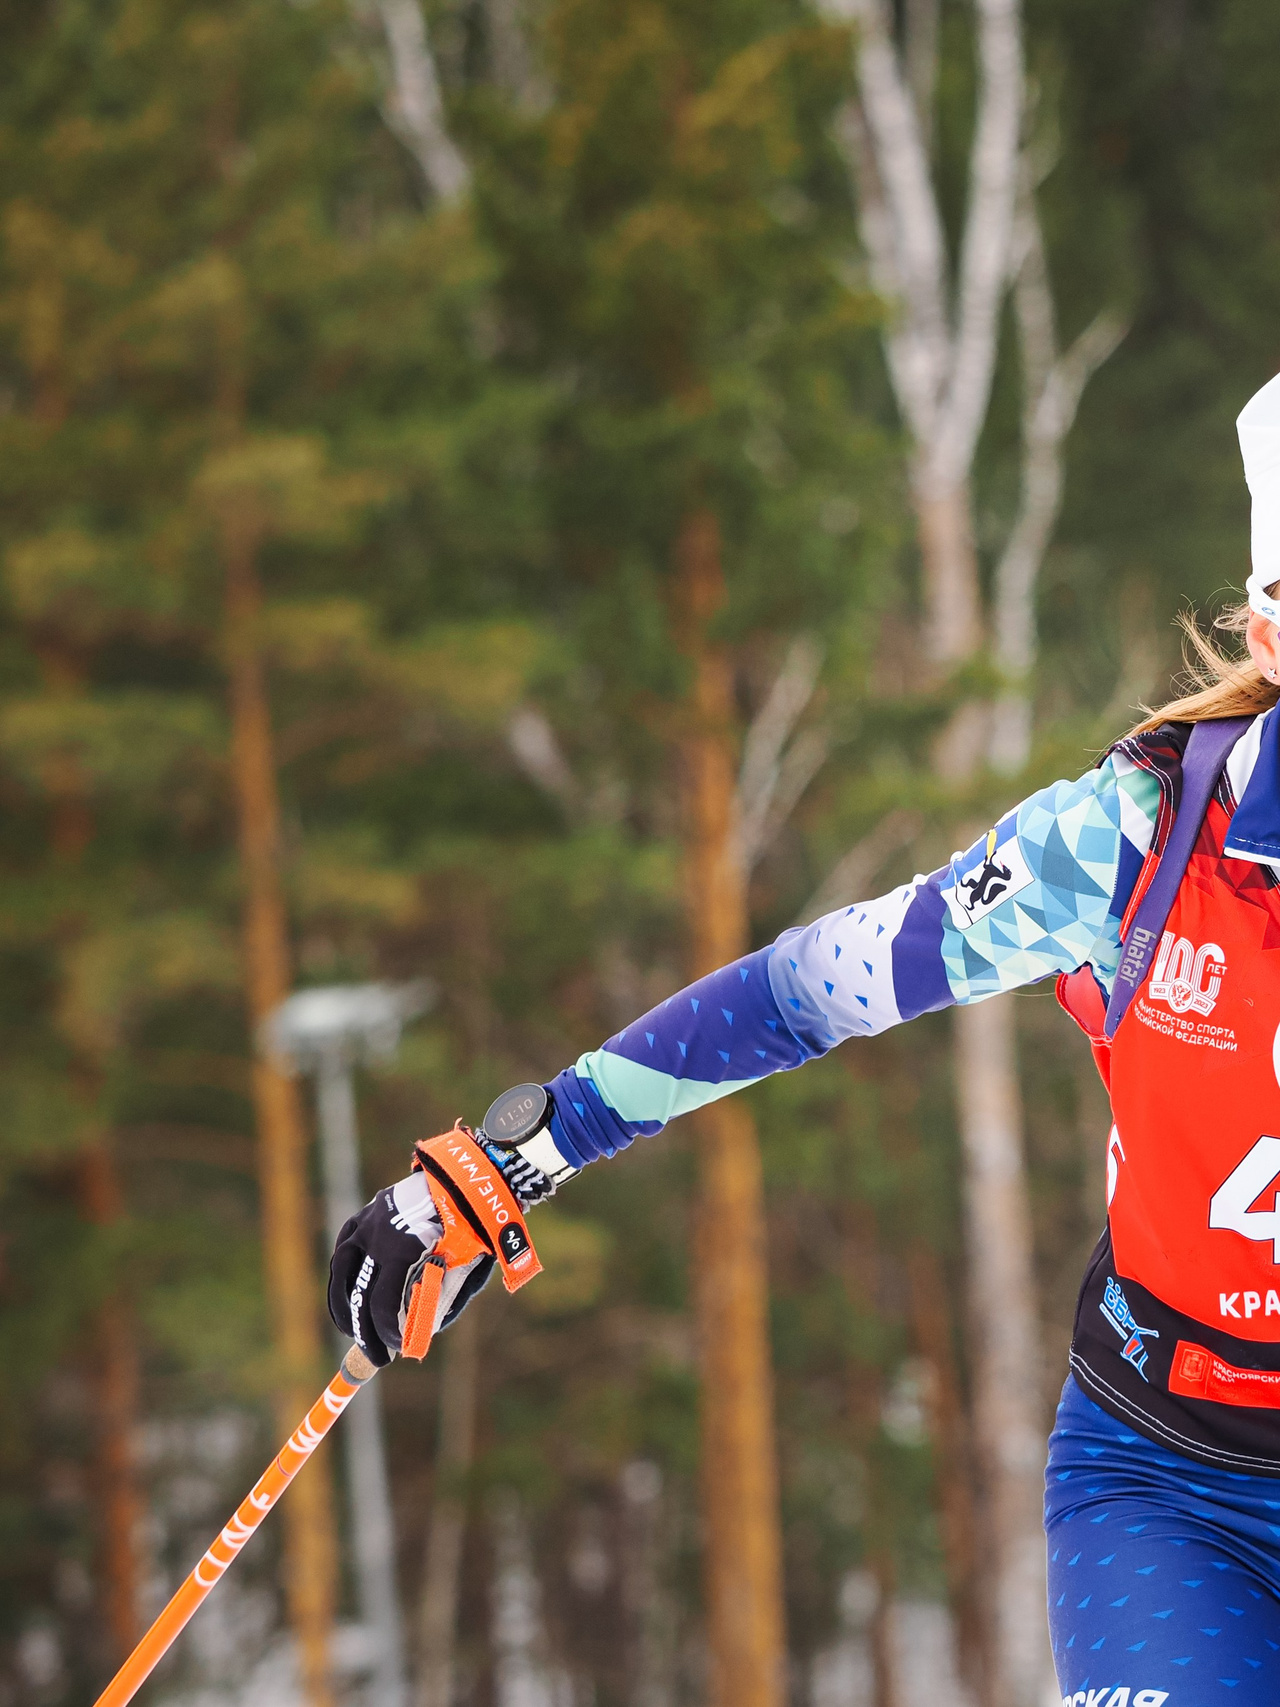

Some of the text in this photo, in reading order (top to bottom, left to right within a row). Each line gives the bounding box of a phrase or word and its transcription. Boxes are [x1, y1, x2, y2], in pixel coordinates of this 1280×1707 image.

[1120, 926, 1157, 988] biatar
[1206, 963, 1228, 976] ЛЕТ
[1193, 998, 1209, 1009] 2023
[1196, 1022, 1236, 1040] СПОРТА
[1175, 1031, 1238, 1052] ФЕДЕРАЦИИ
[500, 1098, 533, 1127] 11:10
[513, 1252, 532, 1271] RIGHT
